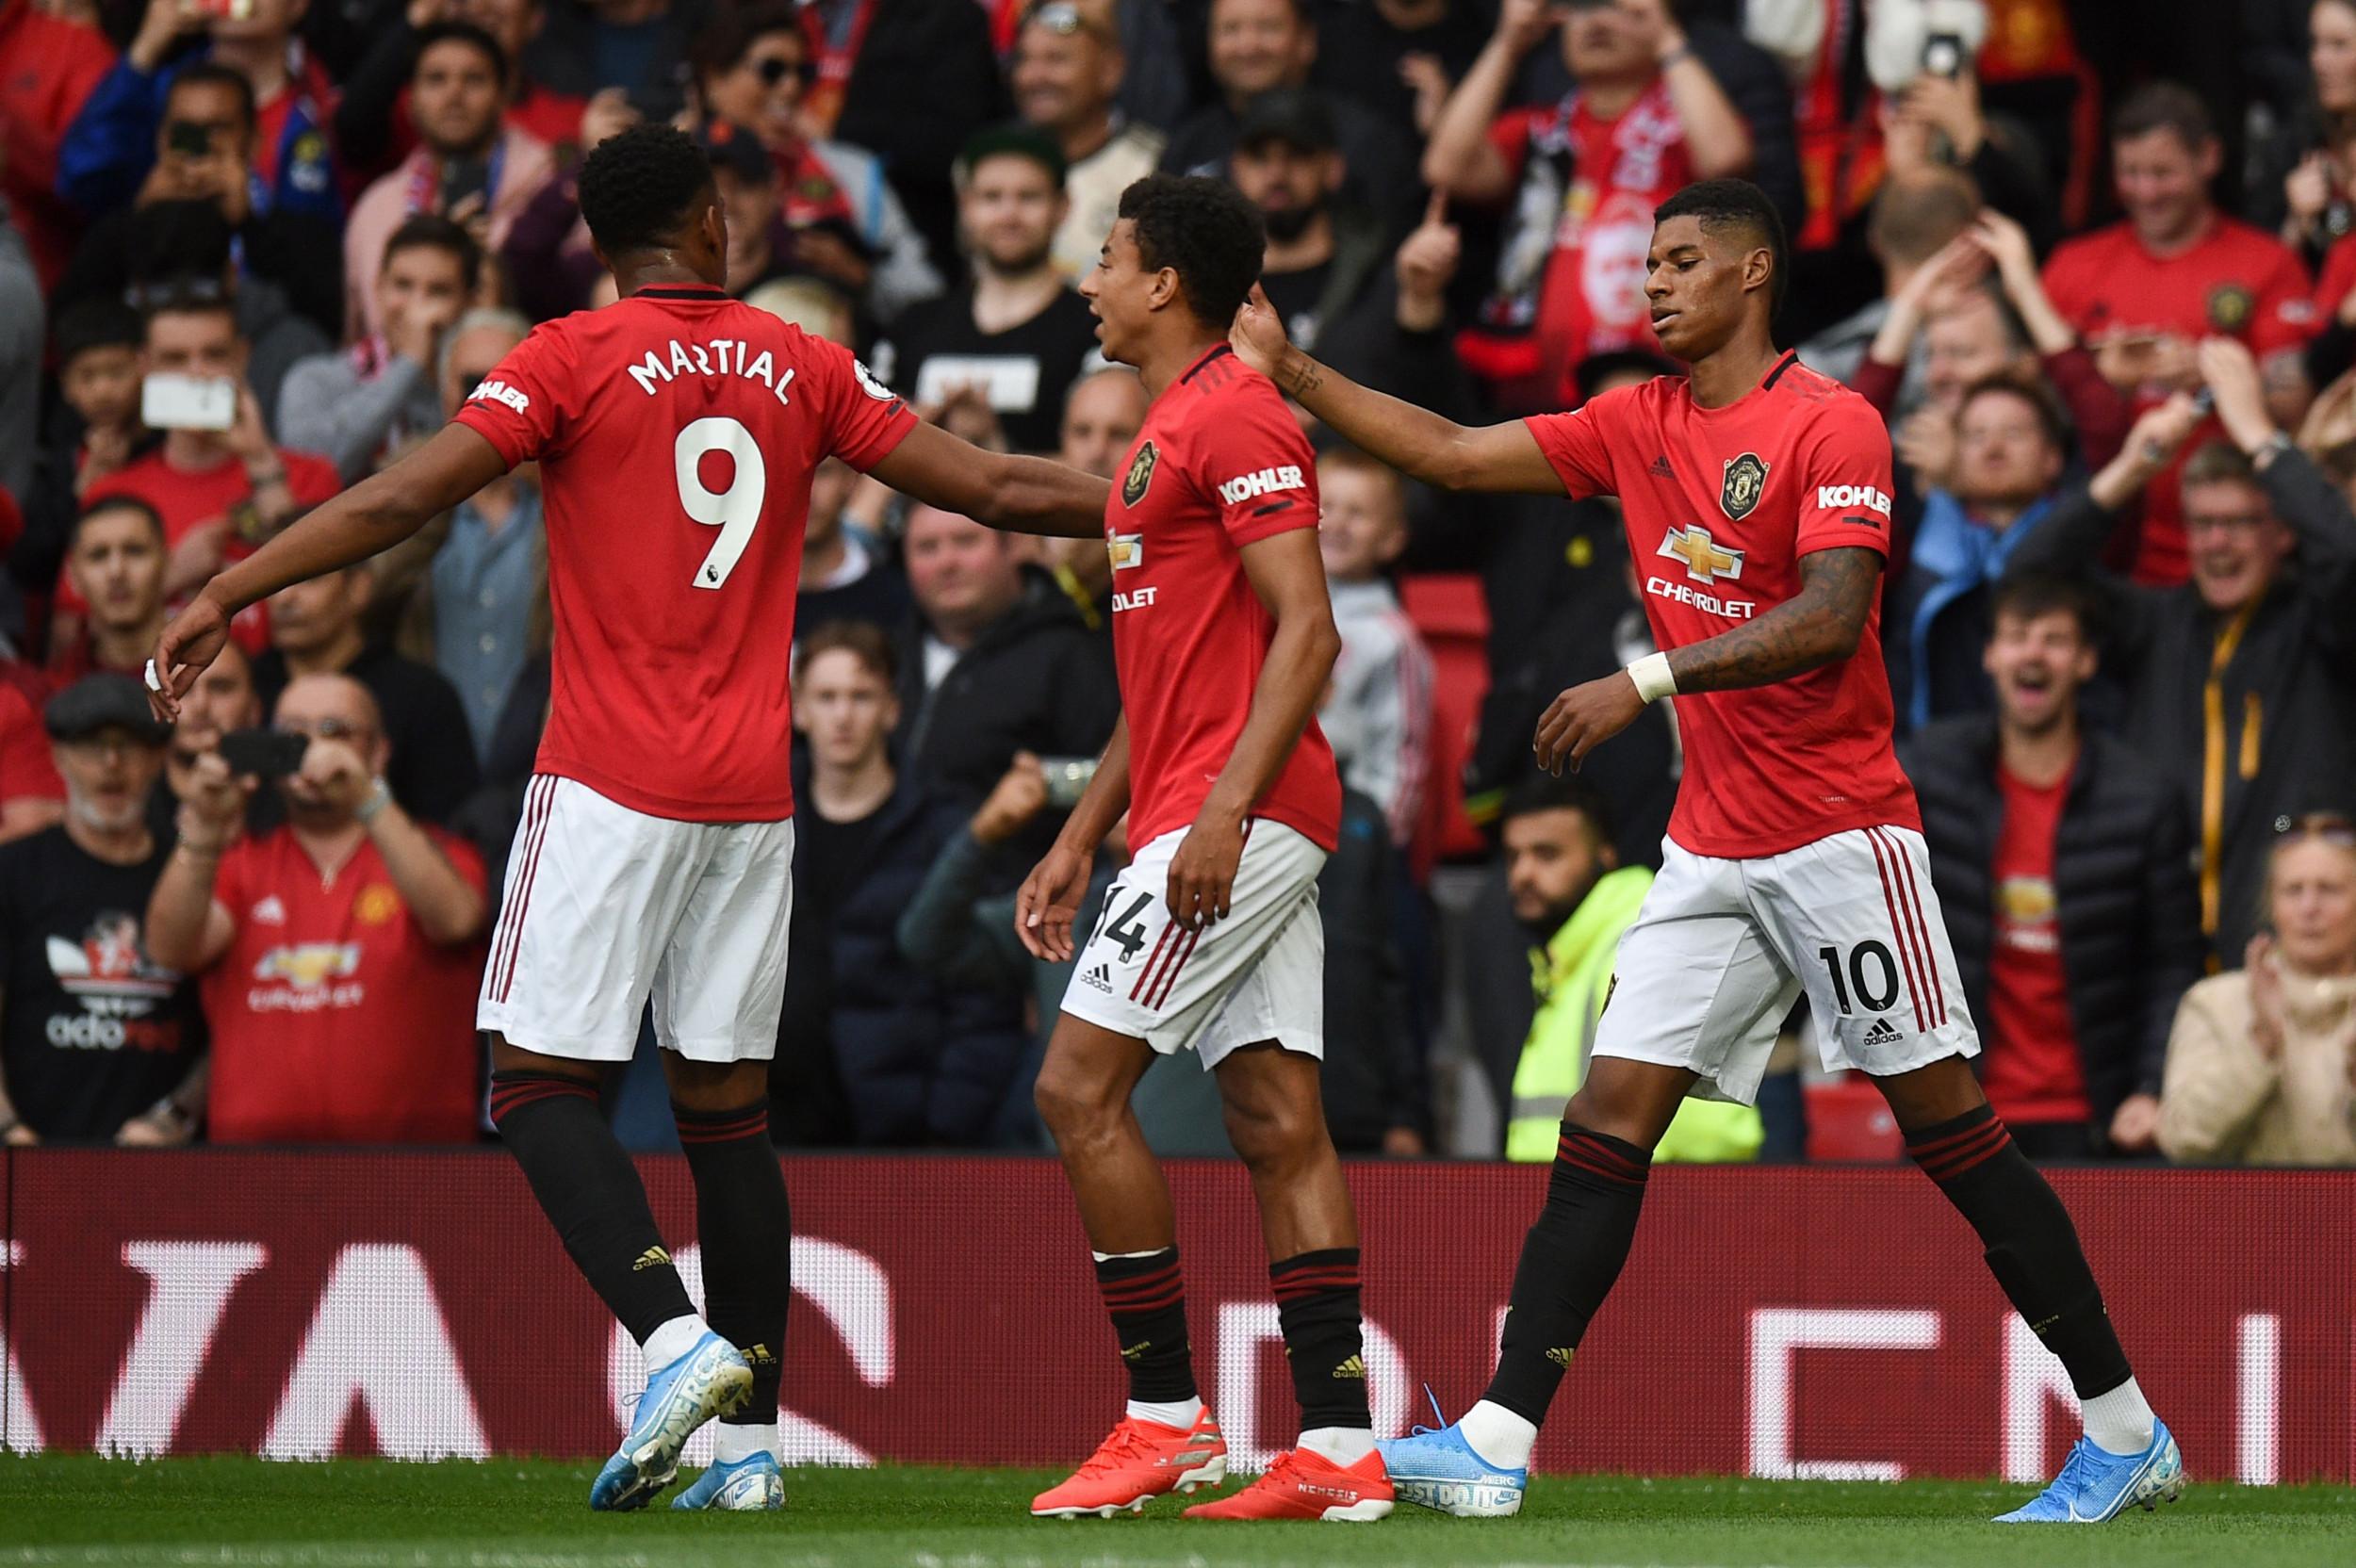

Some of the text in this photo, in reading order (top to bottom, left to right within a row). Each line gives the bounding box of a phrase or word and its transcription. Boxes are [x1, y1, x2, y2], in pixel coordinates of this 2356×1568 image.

[628, 340, 794, 405] MARTIAL
[467, 381, 530, 416] OHLER
[1219, 465, 1306, 506] KOHLER
[675, 417, 766, 590] 9
[1817, 484, 1891, 521] KOHLER
[1645, 576, 1756, 619] CHEVROLET
[1080, 973, 1113, 994] adidas
[1820, 939, 1900, 1015] 10
[1863, 1030, 1904, 1047] adidas
[632, 1257, 673, 1271] adid
[1298, 1483, 1359, 1501] NEMESIS
[1438, 1483, 1472, 1507] DO
[1481, 1475, 1516, 1486] MERC
[1498, 1490, 1517, 1499] NIKE
